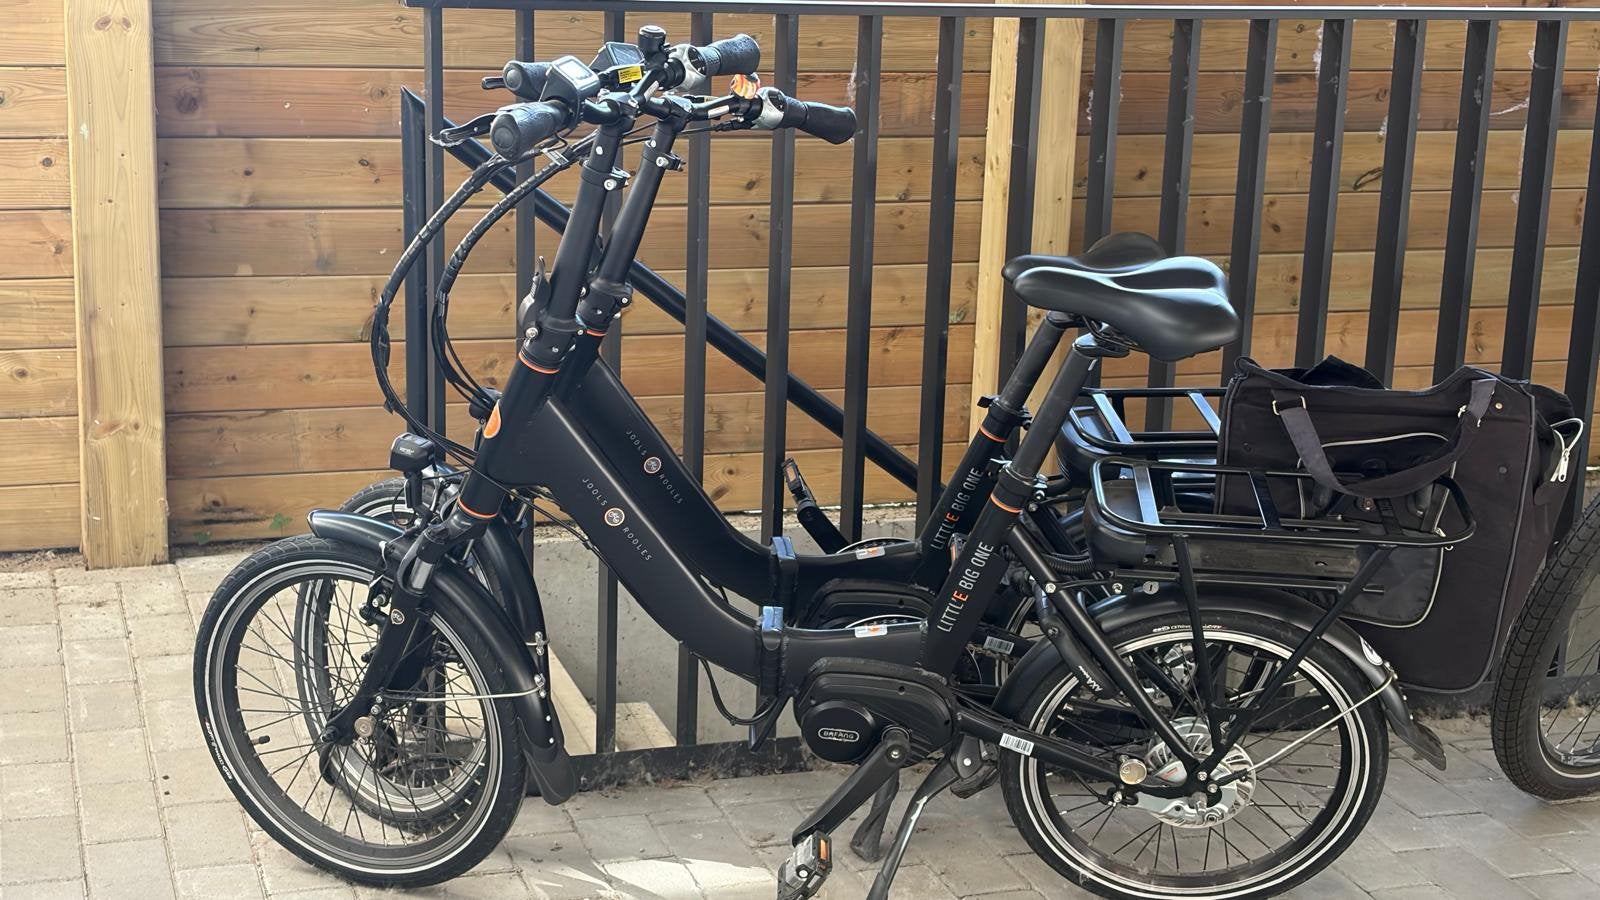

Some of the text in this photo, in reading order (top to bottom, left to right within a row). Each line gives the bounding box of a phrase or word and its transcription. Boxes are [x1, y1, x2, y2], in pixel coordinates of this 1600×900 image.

[626, 430, 683, 504] JOOLS ROOLES
[951, 492, 970, 512] BIG
[962, 467, 984, 491] ONE
[582, 478, 653, 561] JOOLS ROOLES
[958, 568, 980, 590] BIG
[970, 541, 995, 567] ONE
[1086, 676, 1104, 692] AXA
[823, 730, 855, 740] BAFANG
